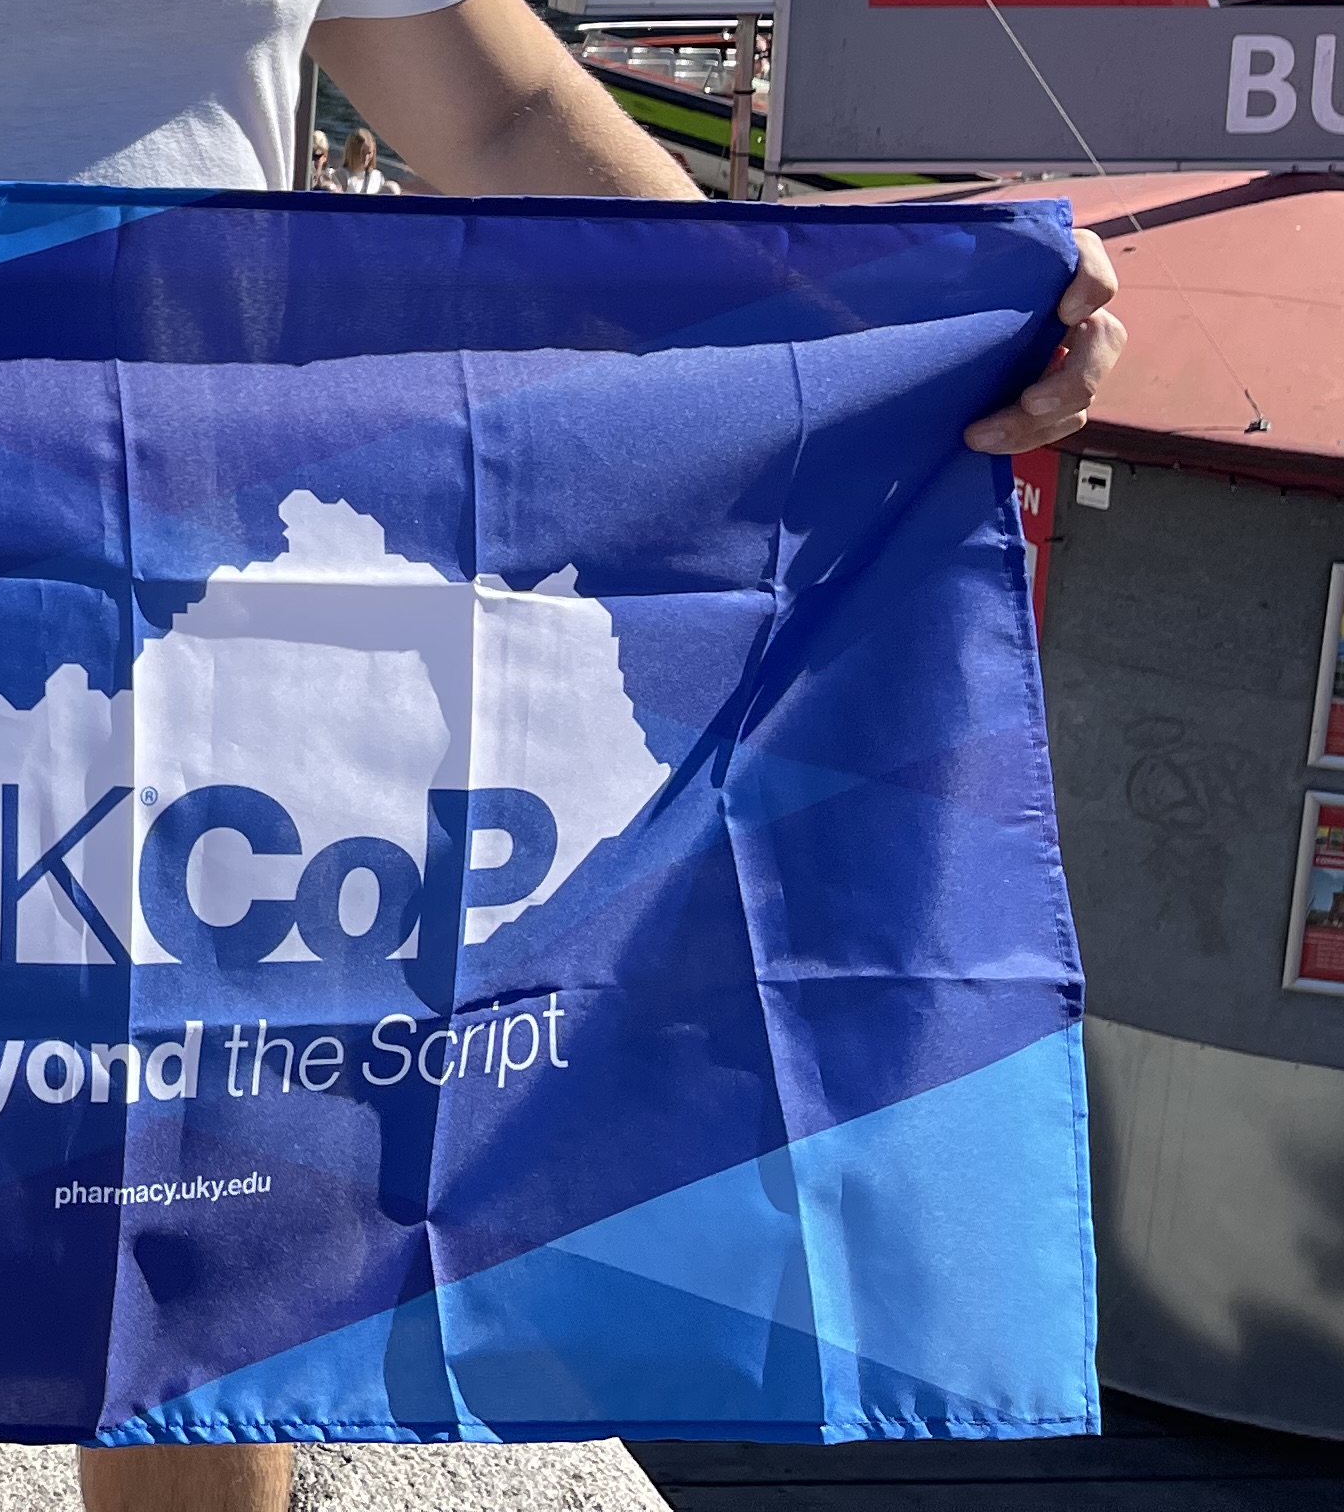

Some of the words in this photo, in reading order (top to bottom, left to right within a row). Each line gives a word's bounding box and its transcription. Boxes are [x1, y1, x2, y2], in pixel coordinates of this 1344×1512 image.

[222, 1018, 346, 1097] the
[360, 992, 570, 1088] Script
[54, 1172, 272, 1209] pharmacy.uky.edu
